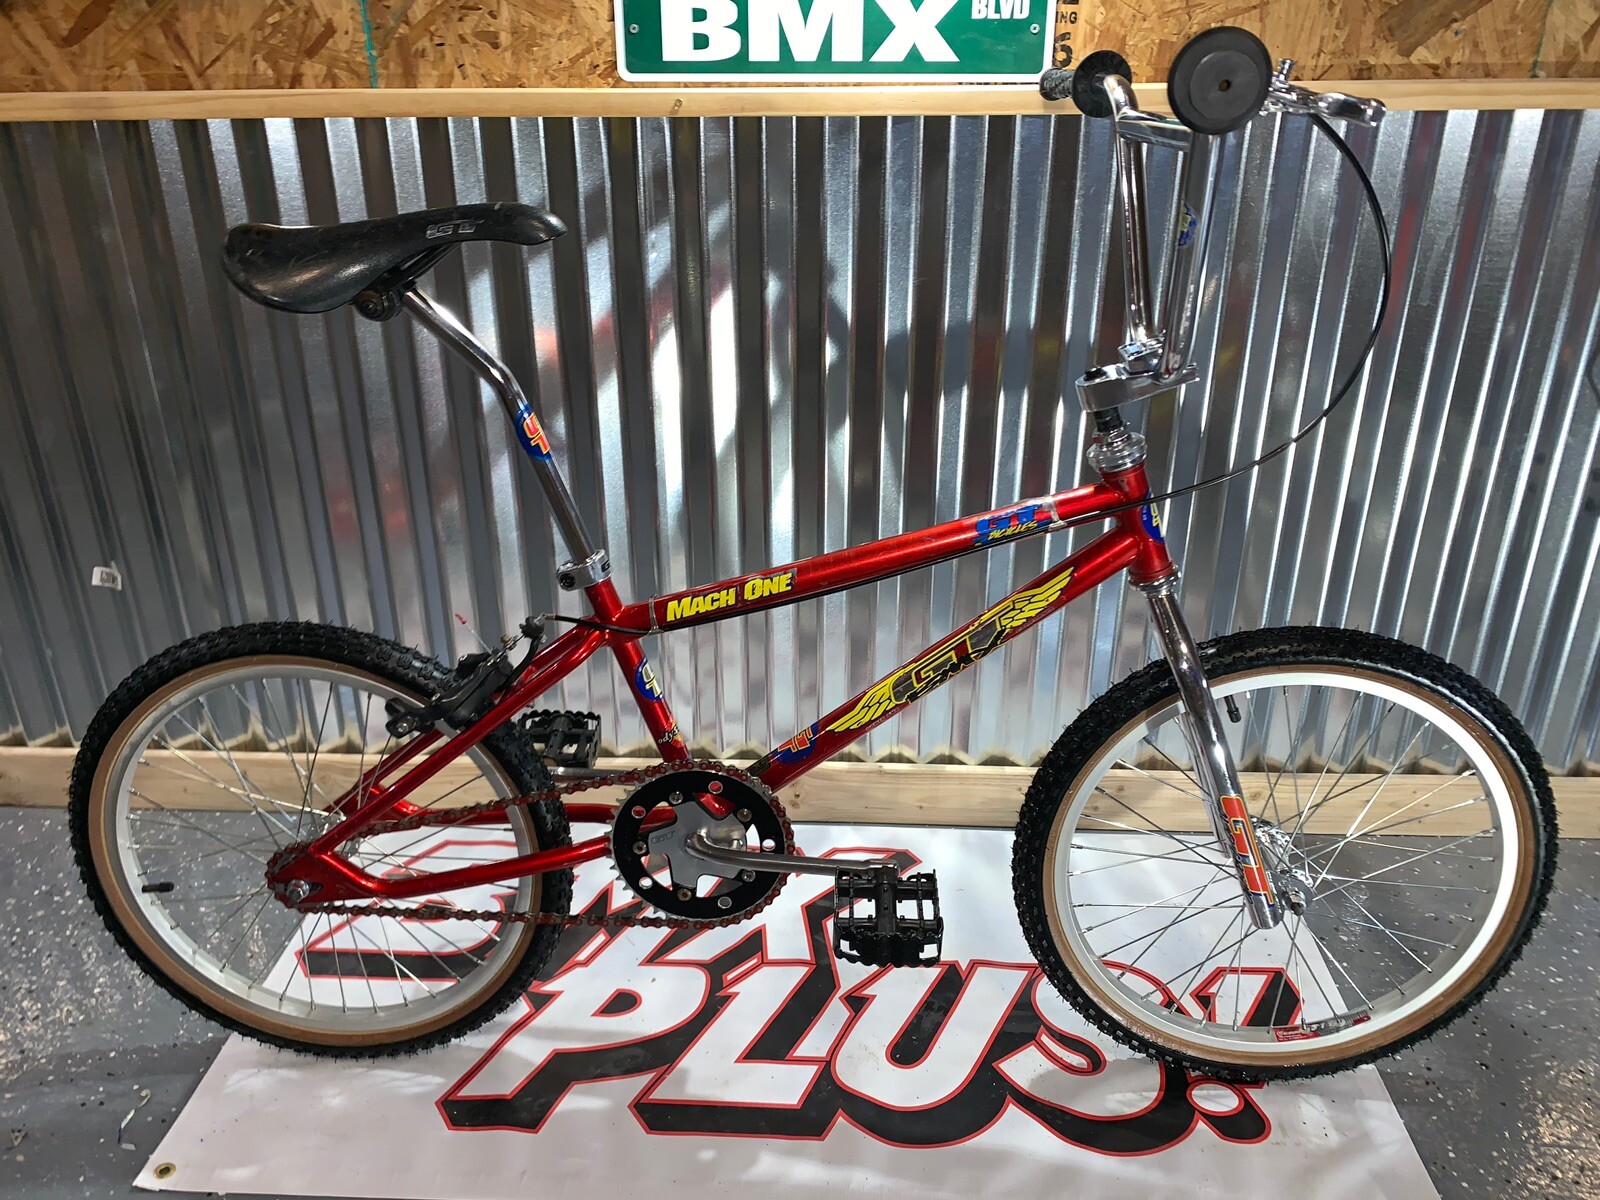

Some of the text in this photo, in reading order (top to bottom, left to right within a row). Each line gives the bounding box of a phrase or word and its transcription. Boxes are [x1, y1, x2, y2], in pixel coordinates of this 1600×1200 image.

[661, 0, 1030, 62] BMX BLVD
[666, 573, 793, 622] MACH ONE
